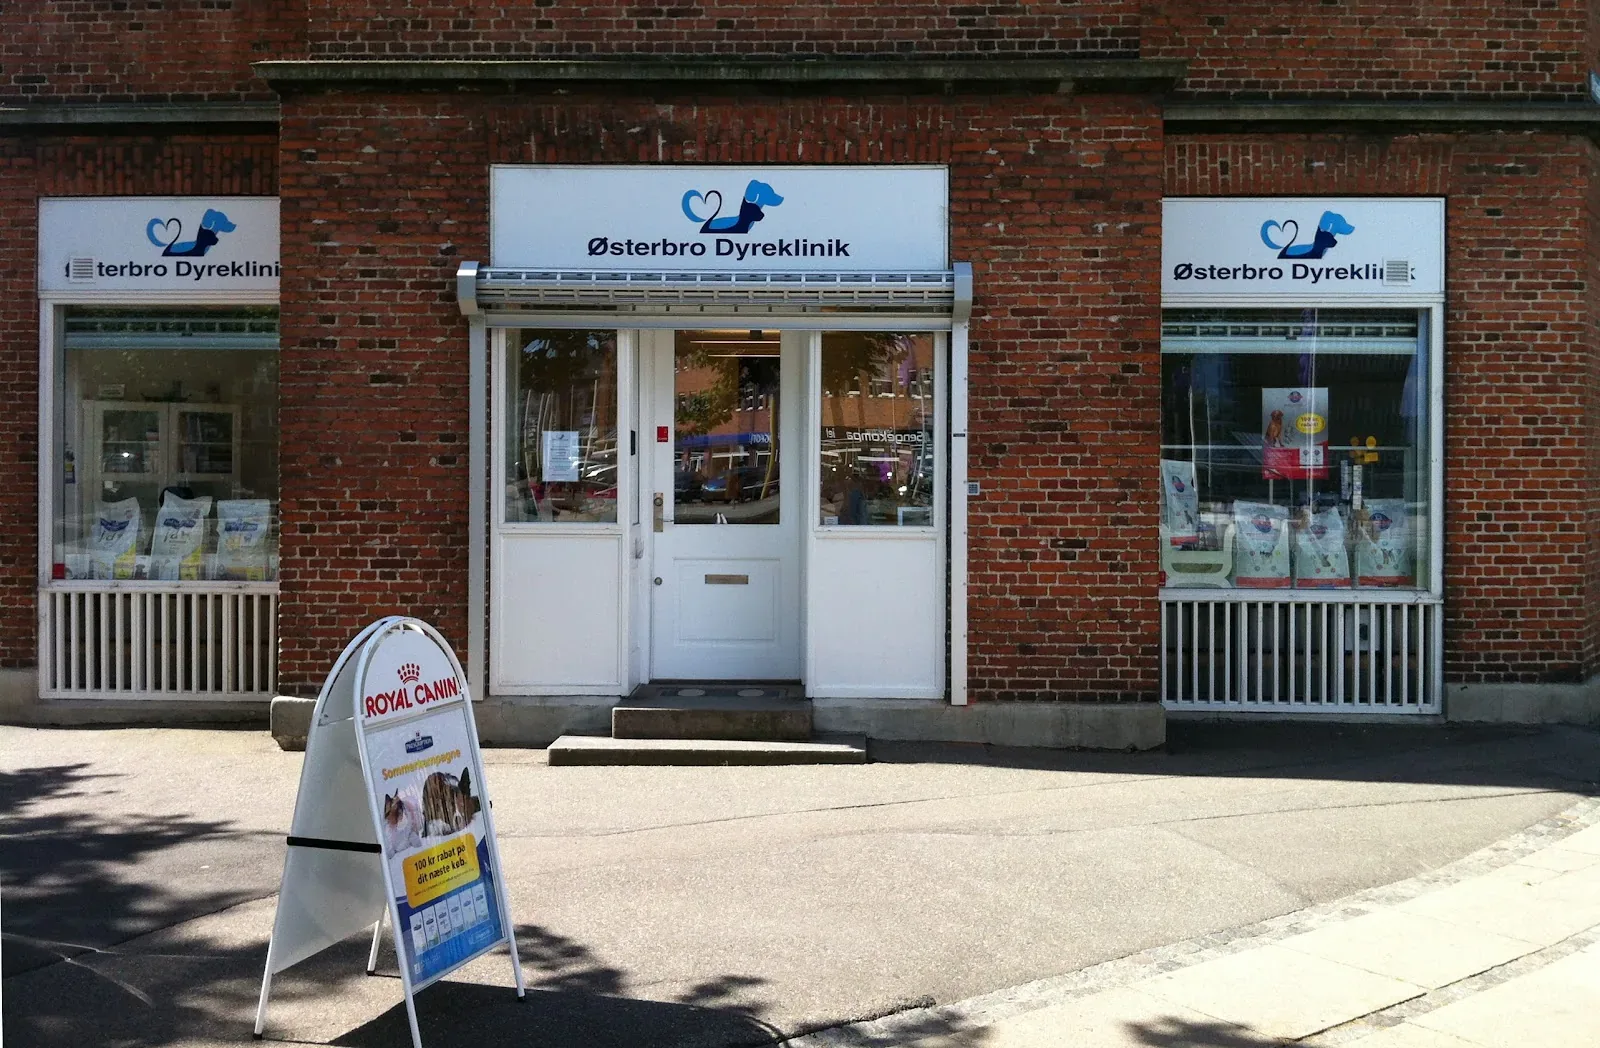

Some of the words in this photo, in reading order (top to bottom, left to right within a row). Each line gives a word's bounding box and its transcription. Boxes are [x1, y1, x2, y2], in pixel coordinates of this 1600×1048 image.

[587, 237, 706, 256] Østerbro
[715, 238, 850, 261] Dyreklinik
[65, 261, 168, 278] terbro
[175, 260, 280, 281] Dyreklini
[1174, 262, 1283, 281] Østerbro
[366, 687, 413, 718] ROYAL
[414, 676, 458, 704] CANIN
[414, 858, 427, 872] 100
[427, 855, 436, 866] kr
[437, 848, 456, 863] rabat
[417, 873, 428, 885] dit
[429, 864, 450, 881] næste
